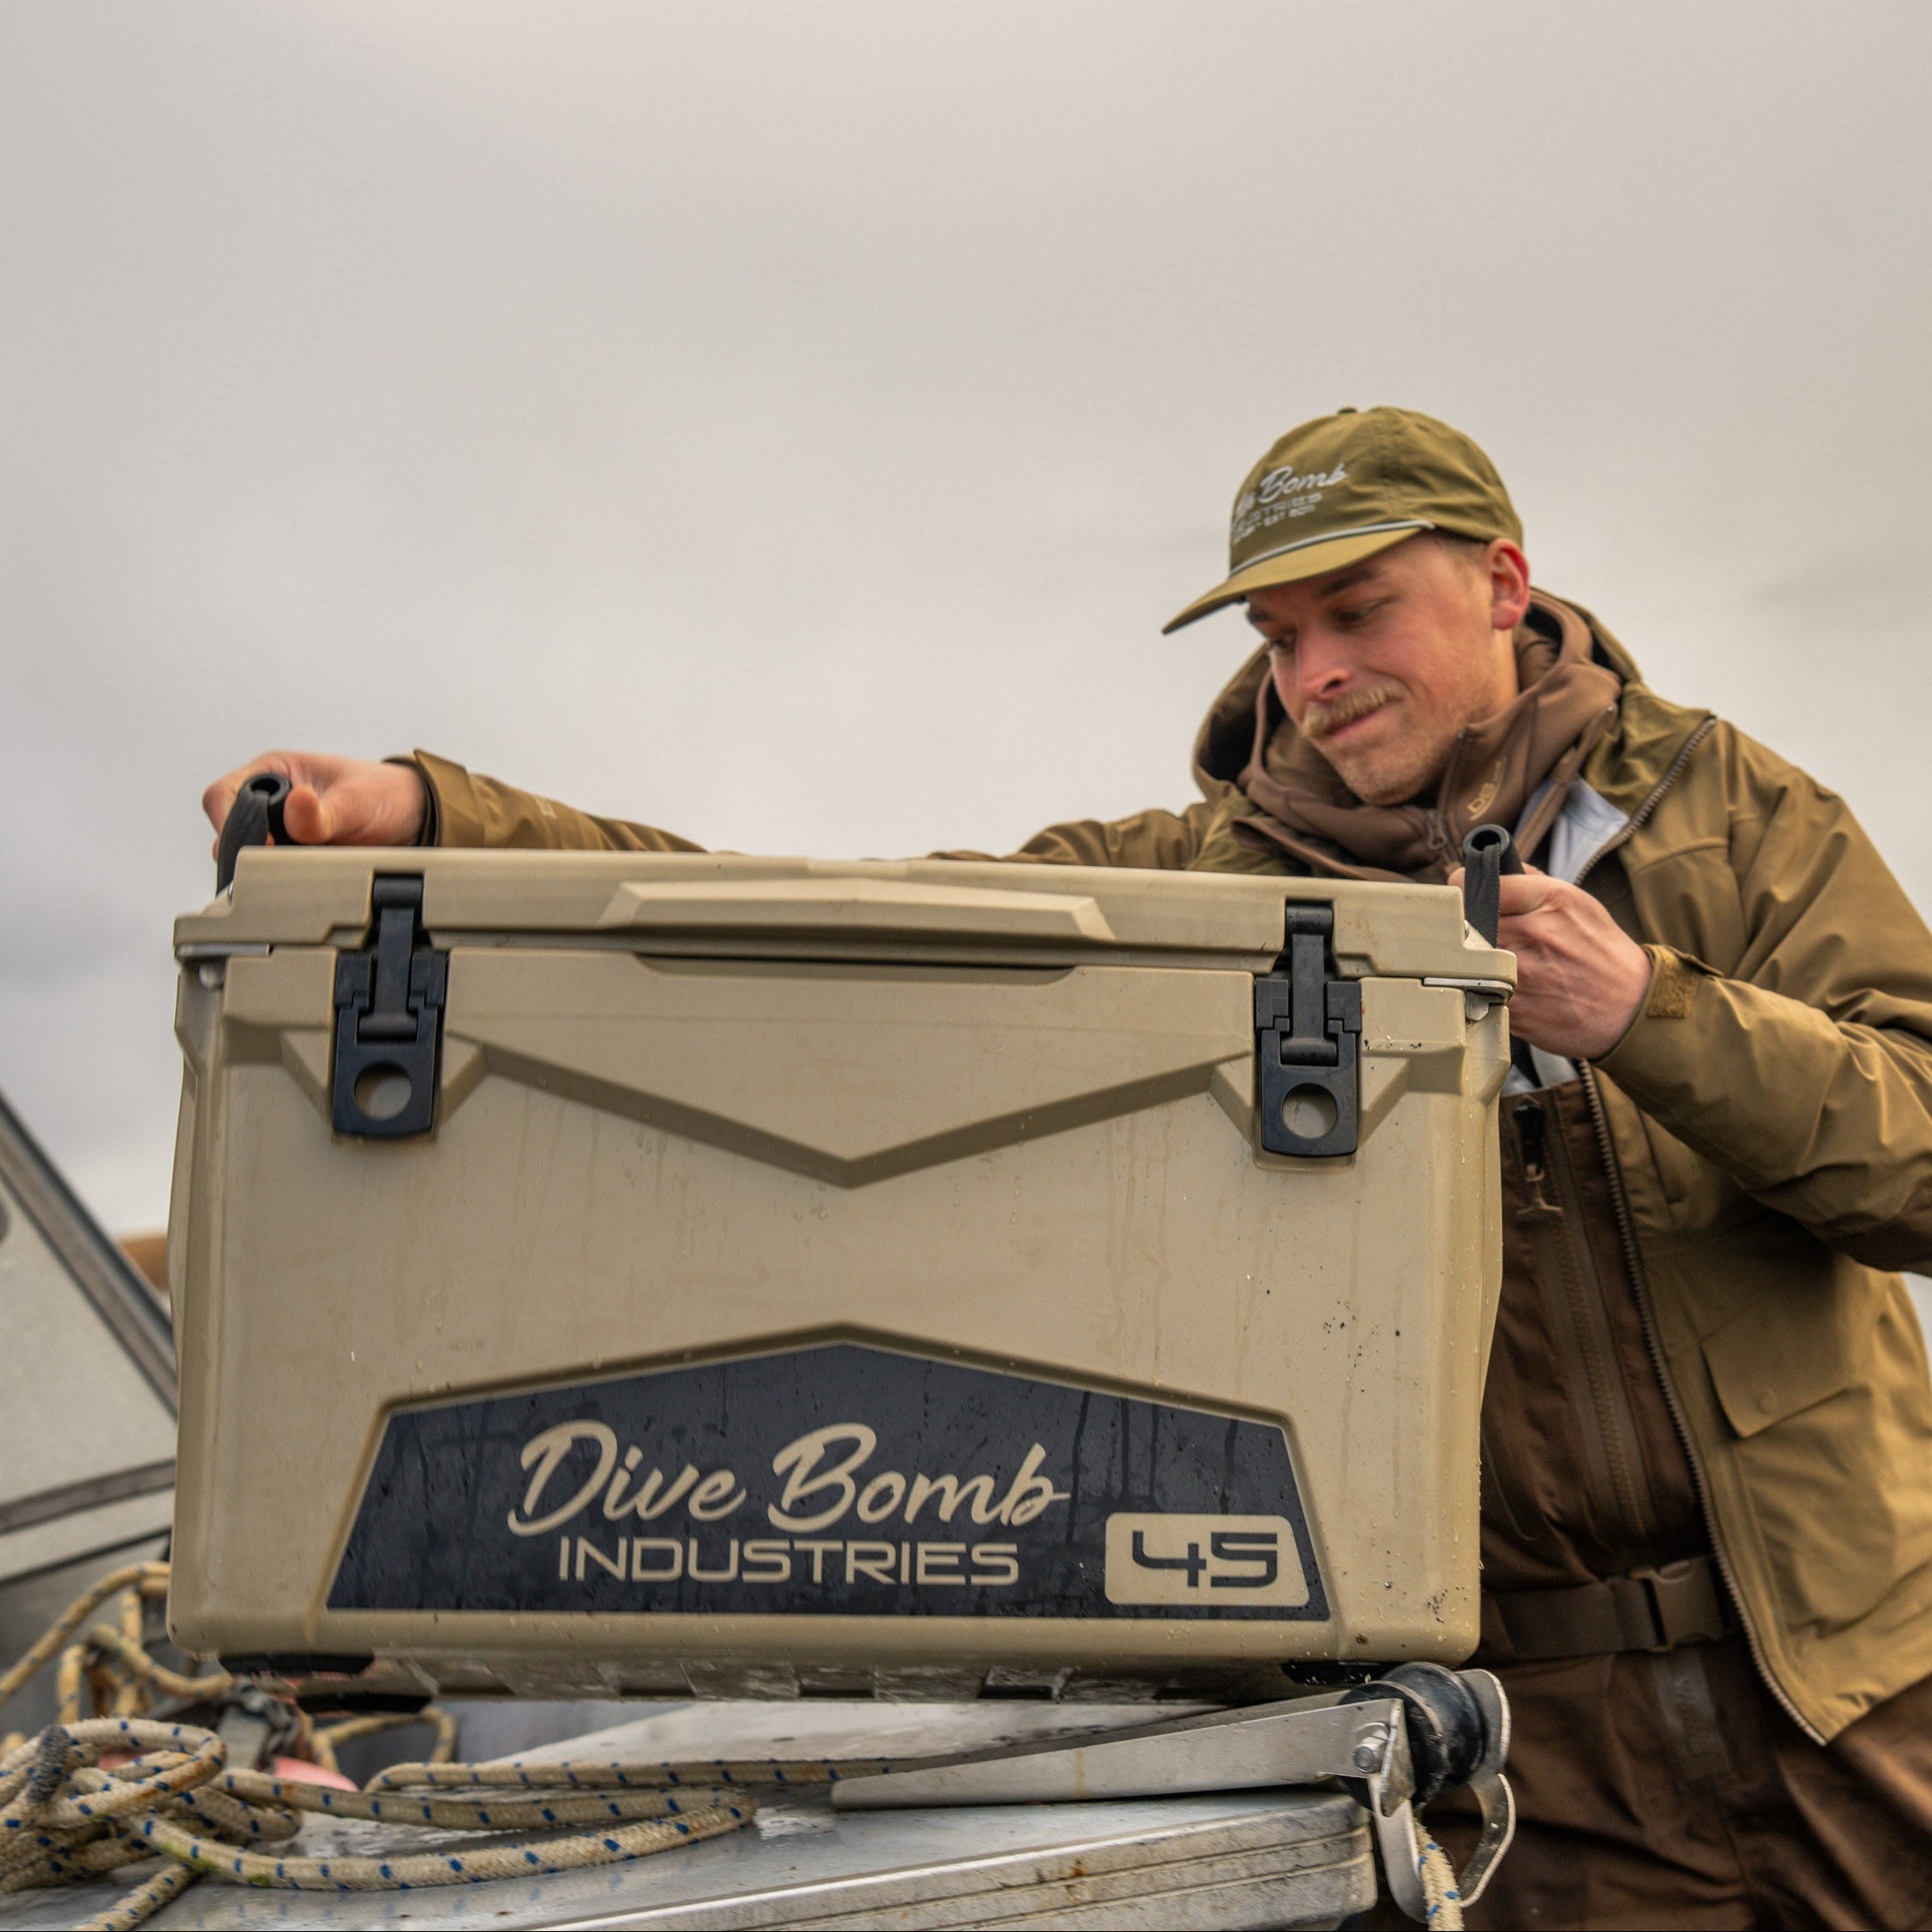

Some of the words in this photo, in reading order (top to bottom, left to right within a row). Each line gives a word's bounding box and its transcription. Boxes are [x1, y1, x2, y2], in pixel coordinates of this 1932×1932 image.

[1258, 462, 1350, 503] Bomb
[507, 1420, 748, 1537] Dive
[767, 1422, 1072, 1533] Bomb
[558, 1537, 1020, 1586] INDUSTRIES
[1131, 1530, 1279, 1589] 45
